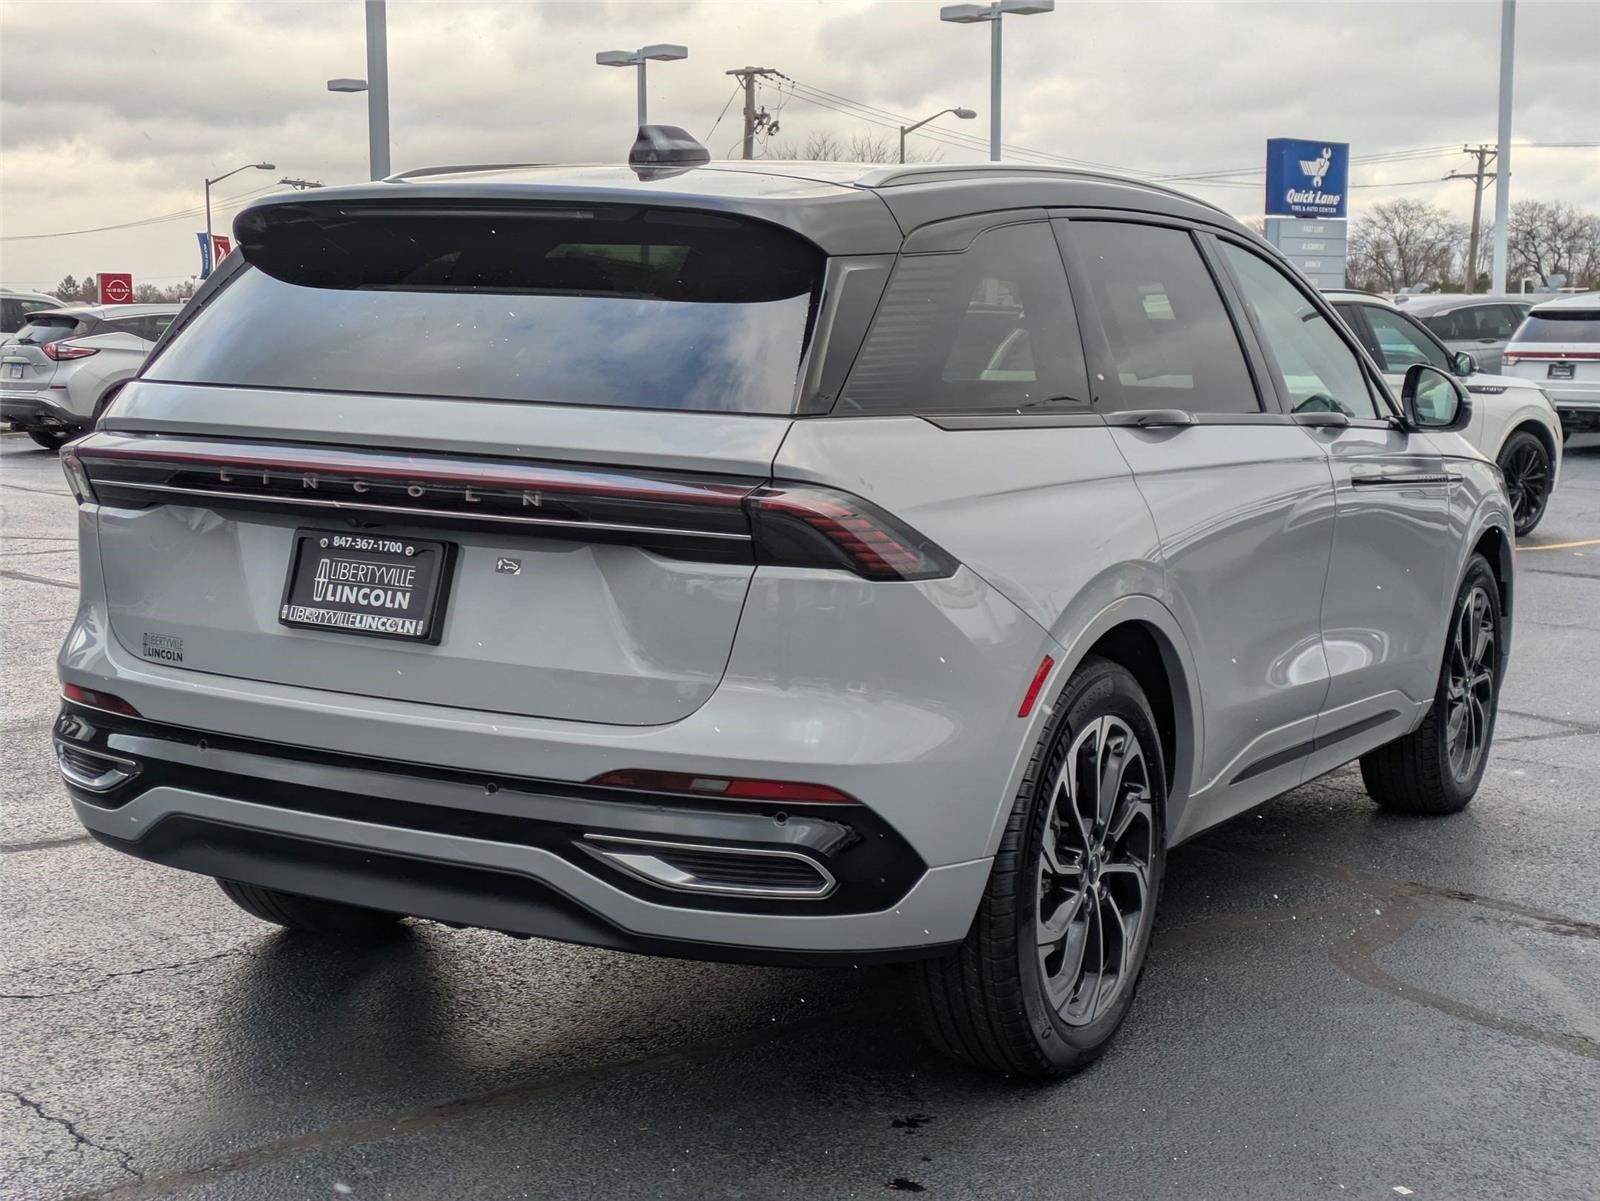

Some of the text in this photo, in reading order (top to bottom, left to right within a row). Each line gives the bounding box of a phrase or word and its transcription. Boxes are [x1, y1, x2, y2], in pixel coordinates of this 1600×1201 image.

[1286, 188, 1341, 205] Quick Lane
[220, 470, 542, 507] LINCOLN
[333, 535, 403, 553] 847-367-1700
[330, 561, 416, 587] LIBERTYVILLE
[325, 583, 410, 610] LINCOLN
[148, 647, 183, 662] LINCOLN
